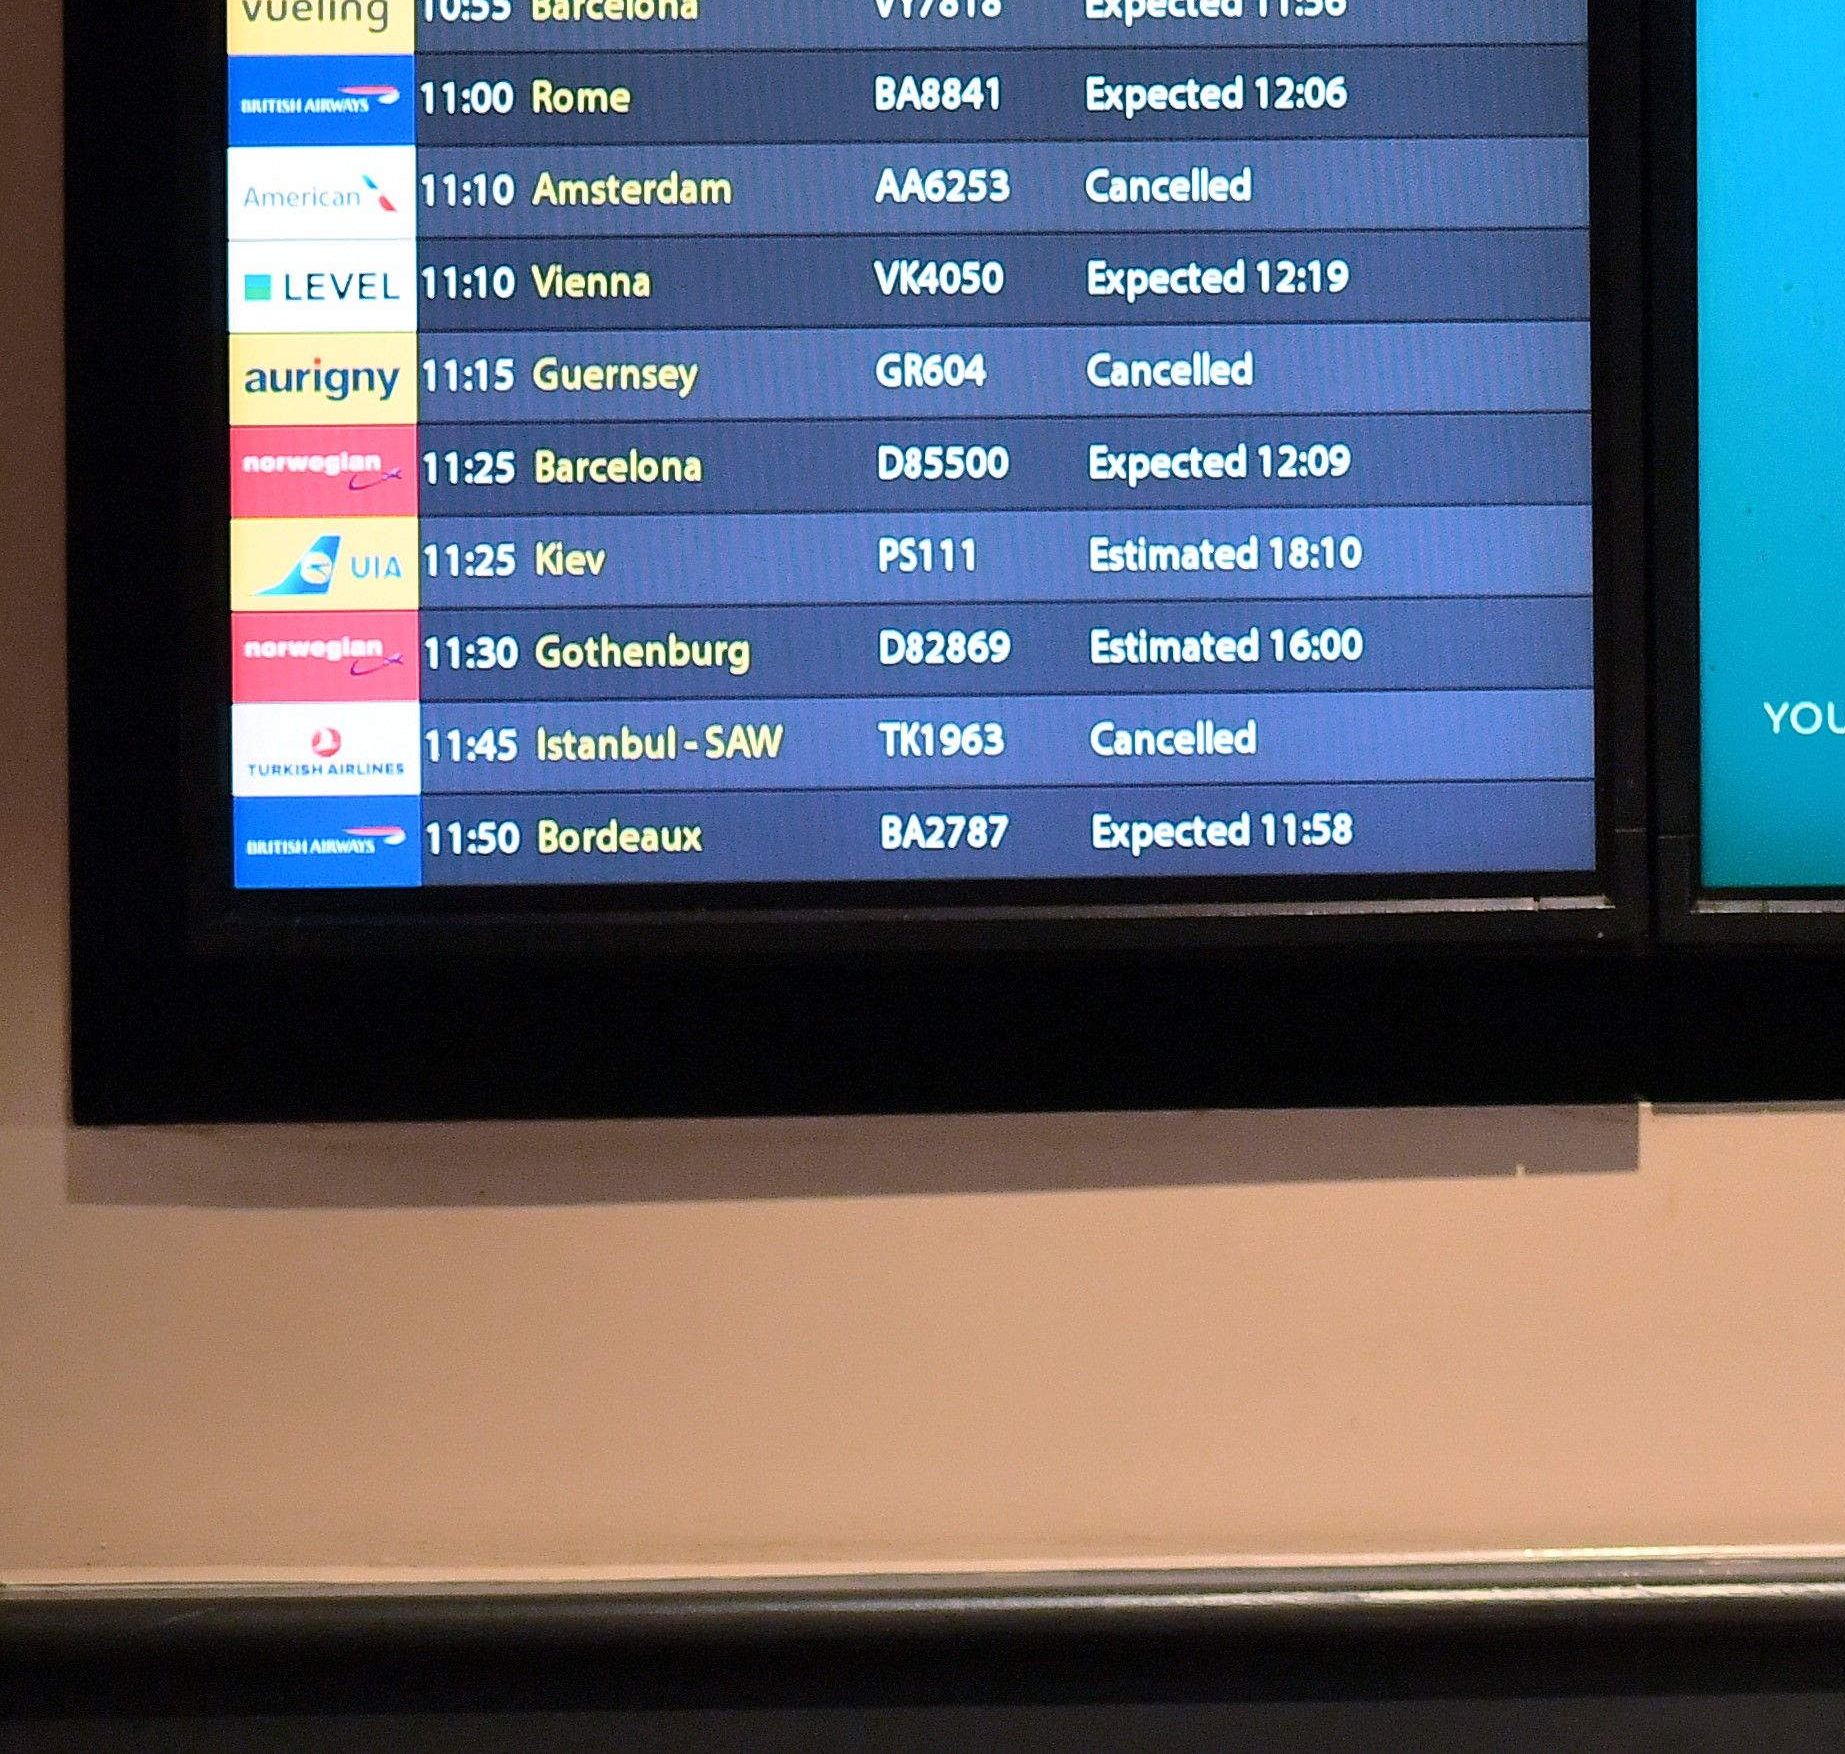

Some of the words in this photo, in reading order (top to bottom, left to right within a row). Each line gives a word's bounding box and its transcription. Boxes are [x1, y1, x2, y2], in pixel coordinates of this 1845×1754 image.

[419, 80, 515, 115] 11:00
[531, 78, 632, 114] Rome
[874, 74, 1000, 112] BA8841
[1085, 74, 1245, 120] Expected
[1254, 75, 1349, 110] 12:06
[422, 170, 516, 207] 11:10
[530, 169, 733, 207] Amsterdam
[874, 166, 1011, 204] AA6253
[1084, 165, 1253, 204] Cancelled
[285, 272, 400, 301] LEVEL
[423, 264, 516, 301] 11:10
[530, 263, 651, 299] Vienna
[872, 258, 1005, 296] VK4050
[1087, 257, 1246, 304] Expected
[1255, 258, 1350, 294] 12:19
[244, 359, 400, 402] aurigny
[351, 556, 401, 579] UIA
[424, 541, 517, 578] 11:25
[535, 540, 607, 577] Kiev
[878, 536, 976, 573] PS111
[1089, 534, 1260, 573] Estimated
[1268, 535, 1364, 571] 18:10
[424, 635, 520, 671] 11:30
[534, 631, 751, 676] Gothenburg
[878, 628, 1012, 666] D82869
[1089, 625, 1260, 665] Estimated
[1269, 627, 1364, 662] 16:00
[425, 725, 519, 762] 11:45
[536, 724, 677, 762] Istanbul
[704, 722, 785, 760] SAW
[876, 720, 1006, 758] TK1963
[1089, 718, 1258, 757] Cancelled
[247, 762, 324, 778] TURKISH
[326, 761, 406, 777] AIRLINES
[425, 820, 521, 856] 11:50
[537, 817, 704, 854] Bordeaux
[880, 813, 1010, 850] BA2787
[1091, 810, 1251, 858] Expected
[1260, 811, 1354, 847] 11:58
